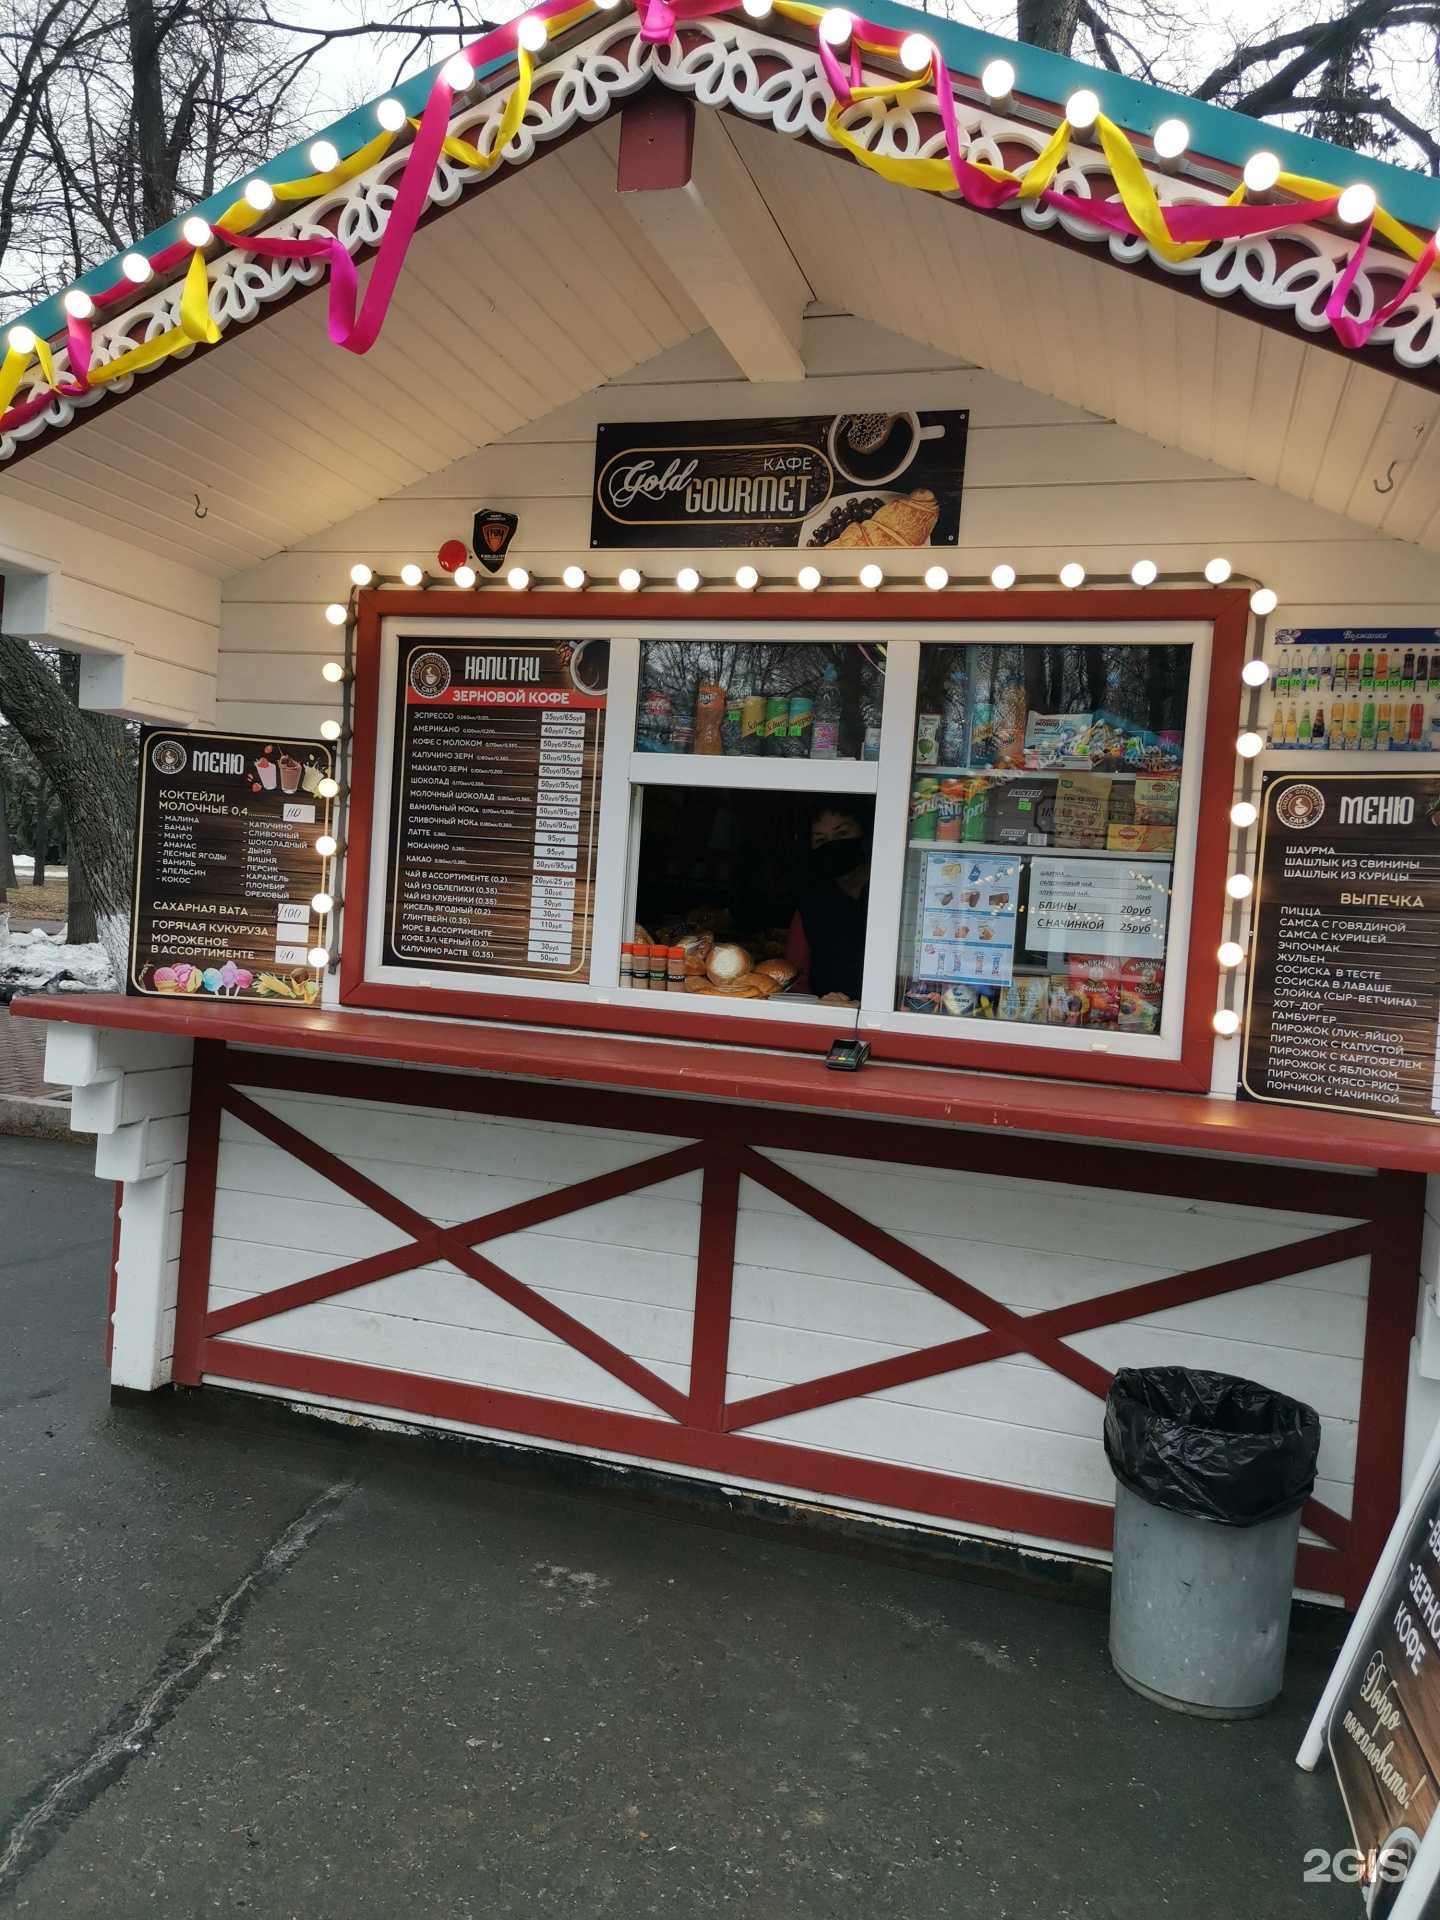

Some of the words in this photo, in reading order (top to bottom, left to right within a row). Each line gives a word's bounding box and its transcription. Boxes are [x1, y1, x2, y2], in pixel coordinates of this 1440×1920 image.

[764, 457, 812, 471] КАФЕ
[609, 458, 699, 508] Gold
[685, 475, 813, 513] GOURMET
[464, 656, 541, 681] НАПИТКИ
[452, 690, 526, 703] ЗЕРНОВОЙ
[528, 692, 570, 704] КОФЕ
[414, 712, 454, 720] ЭСПРЕССО
[413, 725, 460, 733] АМЕРИКАНО
[454, 752, 473, 760] ЗЕРН
[192, 750, 245, 775] МЕНЮ
[449, 765, 468, 773] ЗЕРН
[159, 788, 225, 802] КОКТЕЙЛИ
[410, 790, 453, 798] МОЛОЧНЫЙ
[455, 792, 495, 801] ШОКОЛАД
[159, 801, 229, 815] МОЛОЧНЫЕ
[231, 806, 248, 817] 0,4
[410, 803, 457, 812] ВАНИЛЬНЫЙ
[1339, 796, 1414, 825] МЕНЮ
[164, 814, 200, 823] МАЛИНА
[409, 816, 456, 825] СЛИВОЧНЫЙ
[163, 823, 192, 831] БАНАН
[249, 821, 293, 830] КАПУЧИНО
[163, 832, 193, 841] МАНГО
[248, 830, 299, 839] СЛИВОЧНЫЙ
[163, 842, 197, 850] АНАНАС
[248, 839, 308, 849] ШОКОЛАДНЫЙ
[407, 842, 449, 850] МОКАЧИНО
[163, 850, 197, 859] ЛЕСНЫЕ
[198, 852, 227, 861] ЯГОДЫ
[247, 847, 272, 855] ДЫНЯ
[1286, 846, 1335, 855] ШАУРМА
[162, 859, 197, 867] ВАНИЛЬ
[247, 856, 277, 864] ВИШНЯ
[406, 855, 432, 863] КАКАО
[1285, 858, 1338, 867] ШАШЛЫК
[1342, 859, 1357, 868] ИЗ
[1359, 860, 1420, 869] СВИНИНЫ
[162, 868, 206, 876] АПЕЛЬСИН
[246, 865, 279, 873] ПЕРСИК
[161, 876, 192, 884] КОКОС
[246, 874, 289, 882] КАРАМЕЛЬ
[405, 870, 421, 878] ЧАЙ
[429, 872, 490, 883] АССОРТИМЕНТЕ
[1284, 869, 1338, 879] ШАШЛЫК
[1341, 871, 1357, 879] ИЗ
[1359, 872, 1409, 882] КУРИЦЫ
[245, 882, 285, 890] ПЛОМБИР
[433, 884, 475, 893] ОБЛЕПИХИ
[245, 890, 290, 899] ОРЕХОВЫЙ
[404, 892, 419, 900] ЧАЙ
[432, 894, 474, 903] КЛУБНИКИ
[1340, 893, 1424, 908] ВЫПЕЧКА
[153, 901, 217, 914] САХАРНАЯ
[220, 905, 249, 916] ВАТА
[403, 903, 433, 911] КИСЕЛЬ
[435, 905, 474, 914] ЯГОДНЫЙ
[1039, 901, 1077, 910] БЛИНЫ
[1120, 905, 1152, 915] 20руб
[1280, 907, 1321, 917] ПИЦЦА
[403, 914, 448, 923] ГЛИНТВЕЙН
[152, 919, 207, 933] ГОРЯЧАЯ
[208, 923, 269, 937] КУКУРУЗА
[1046, 919, 1104, 929] НАЧИНКОЙ
[1120, 923, 1151, 933] 25руб
[1279, 918, 1319, 927] САМСА
[1332, 921, 1406, 932] ГОВЯДИНОЙ
[432, 927, 493, 936] АССОРТИМЕНТЕ
[1278, 930, 1318, 939] САМСА
[1331, 932, 1387, 943] КУРИЦЕЙ
[151, 933, 229, 947] МОРОЖЕНОЕ
[439, 937, 471, 945] ЧЕРНЫЙ
[151, 945, 159, 953] В
[160, 945, 255, 960] АССОРТИМЕНТЕ
[401, 945, 442, 954] КАПУЧИНО
[1278, 942, 1340, 952] ЭЧПОЧМАК
[1277, 953, 1325, 963] ЖУЛЬЕН
[1276, 964, 1330, 976] СОСИСКА
[1346, 969, 1382, 979] ТЕСТЕ
[1275, 977, 1330, 988] СОСИСКА
[1342, 982, 1392, 992] ЛАВАШЕ
[1273, 988, 1321, 1000] СЛОЙКА
[1324, 991, 1417, 1007] (СЫР-ВЕТЧИНА)
[1273, 1000, 1325, 1011] ХОТ-ДОГ
[1272, 1011, 1337, 1024] ГАМБУРГЕР
[1271, 1023, 1329, 1035] ПИРОЖОК
[1332, 1028, 1403, 1042] (ЛУК-ЯЙЦО)
[1270, 1034, 1328, 1047] ПИРОЖОК
[1331, 1040, 1338, 1048] С
[1341, 1040, 1404, 1055] КАПУСТОЙ
[1269, 1046, 1327, 1058] ПИРОЖОК
[1330, 1052, 1338, 1060] С
[1340, 1052, 1422, 1069] КАРТОФЕЛЕМ
[1268, 1058, 1326, 1070] ПИРОЖОК
[1329, 1064, 1337, 1072] С
[1339, 1065, 1398, 1079] ЯБЛОКОМ
[1268, 1069, 1325, 1082] ПИРОЖОК
[1328, 1076, 1400, 1092] (МЯСО-РИС)
[1267, 1081, 1322, 1094] ПОНЧИКИ
[1335, 1088, 1400, 1104] НАЧИНКОЙ
[1410, 1565, 1440, 1649] ЗЕРНО
[1394, 1600, 1426, 1676] КОФЕ
[1360, 1650, 1400, 1737] Добро
